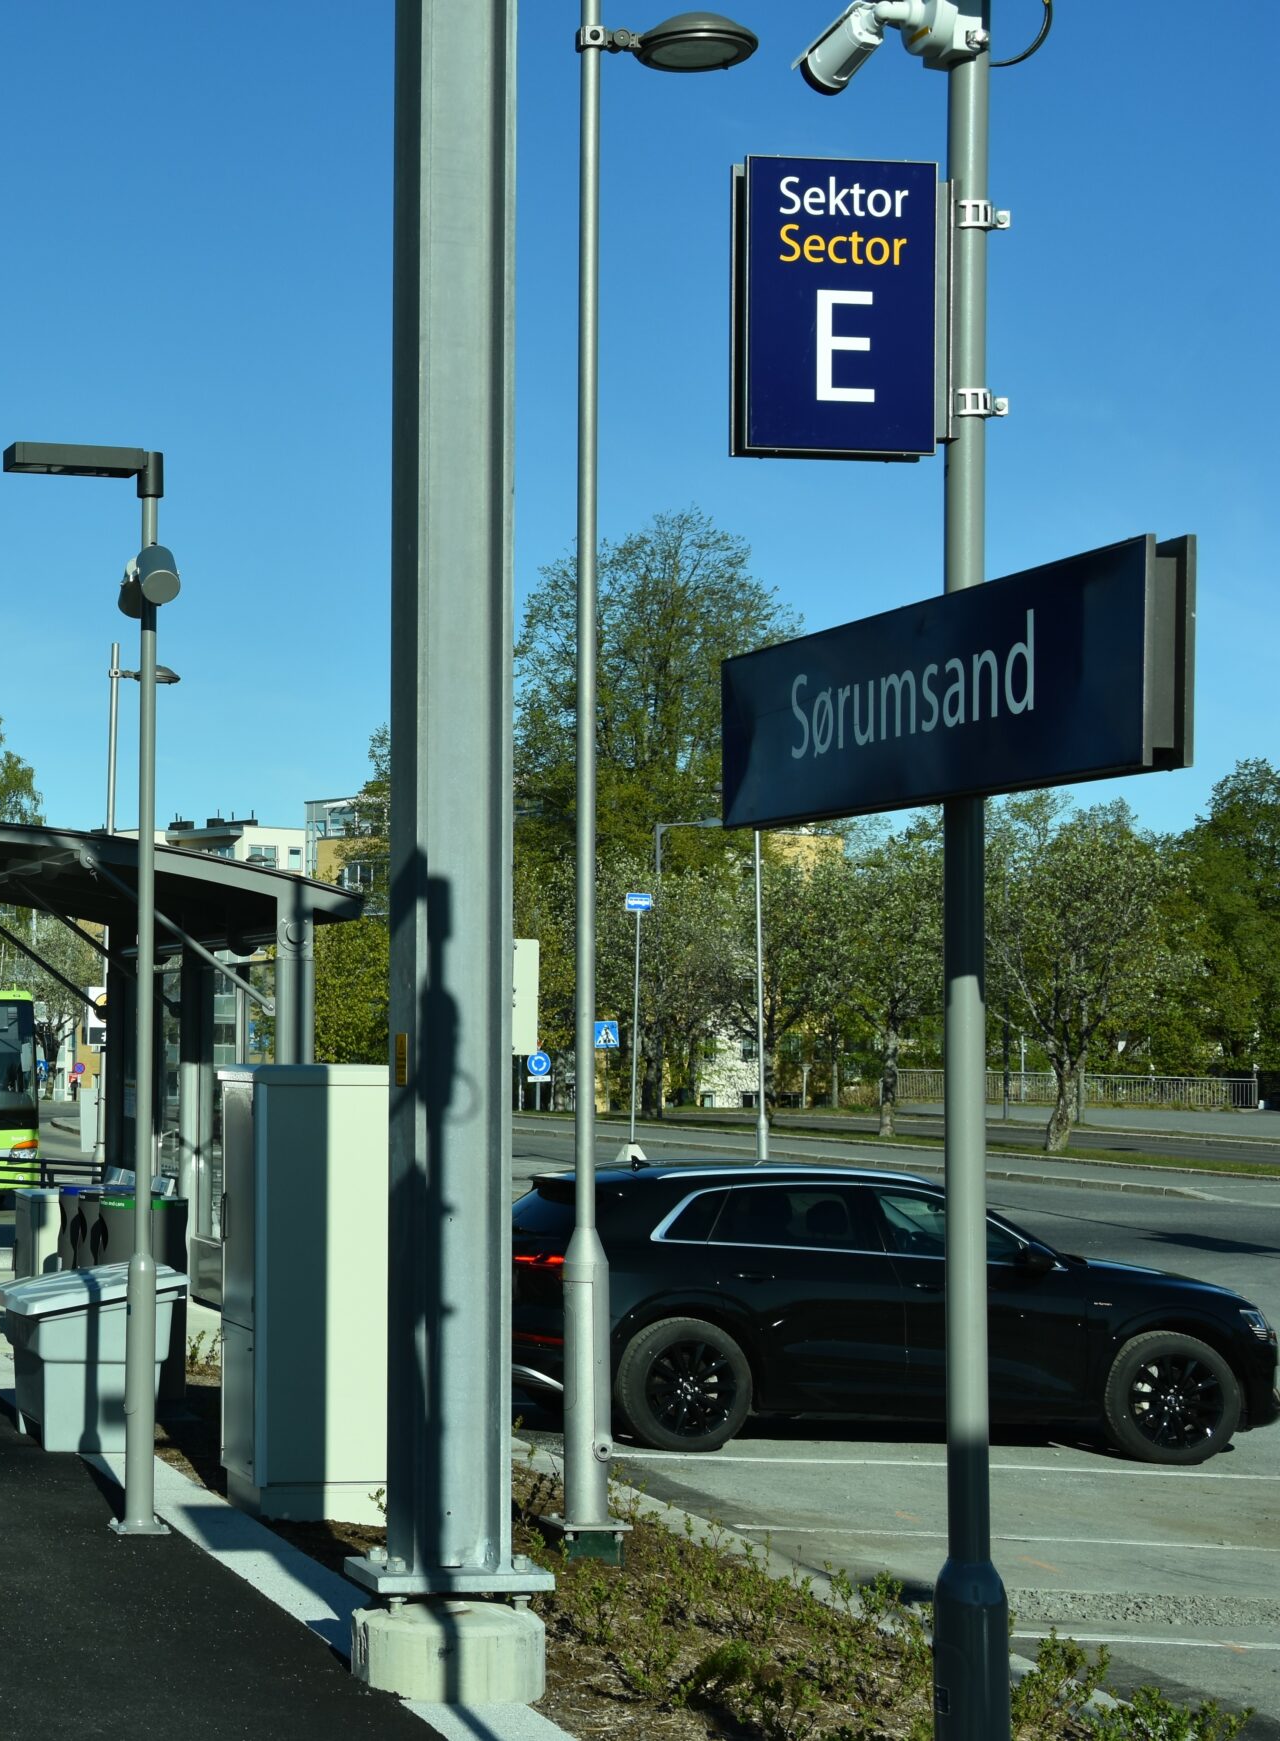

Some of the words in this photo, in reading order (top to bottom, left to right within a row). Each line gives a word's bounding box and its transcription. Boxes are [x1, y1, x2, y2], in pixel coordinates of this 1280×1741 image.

[779, 175, 910, 218] Sektor
[779, 223, 908, 266] Sector
[816, 289, 876, 403] E
[791, 608, 1035, 760] Sørumsand
